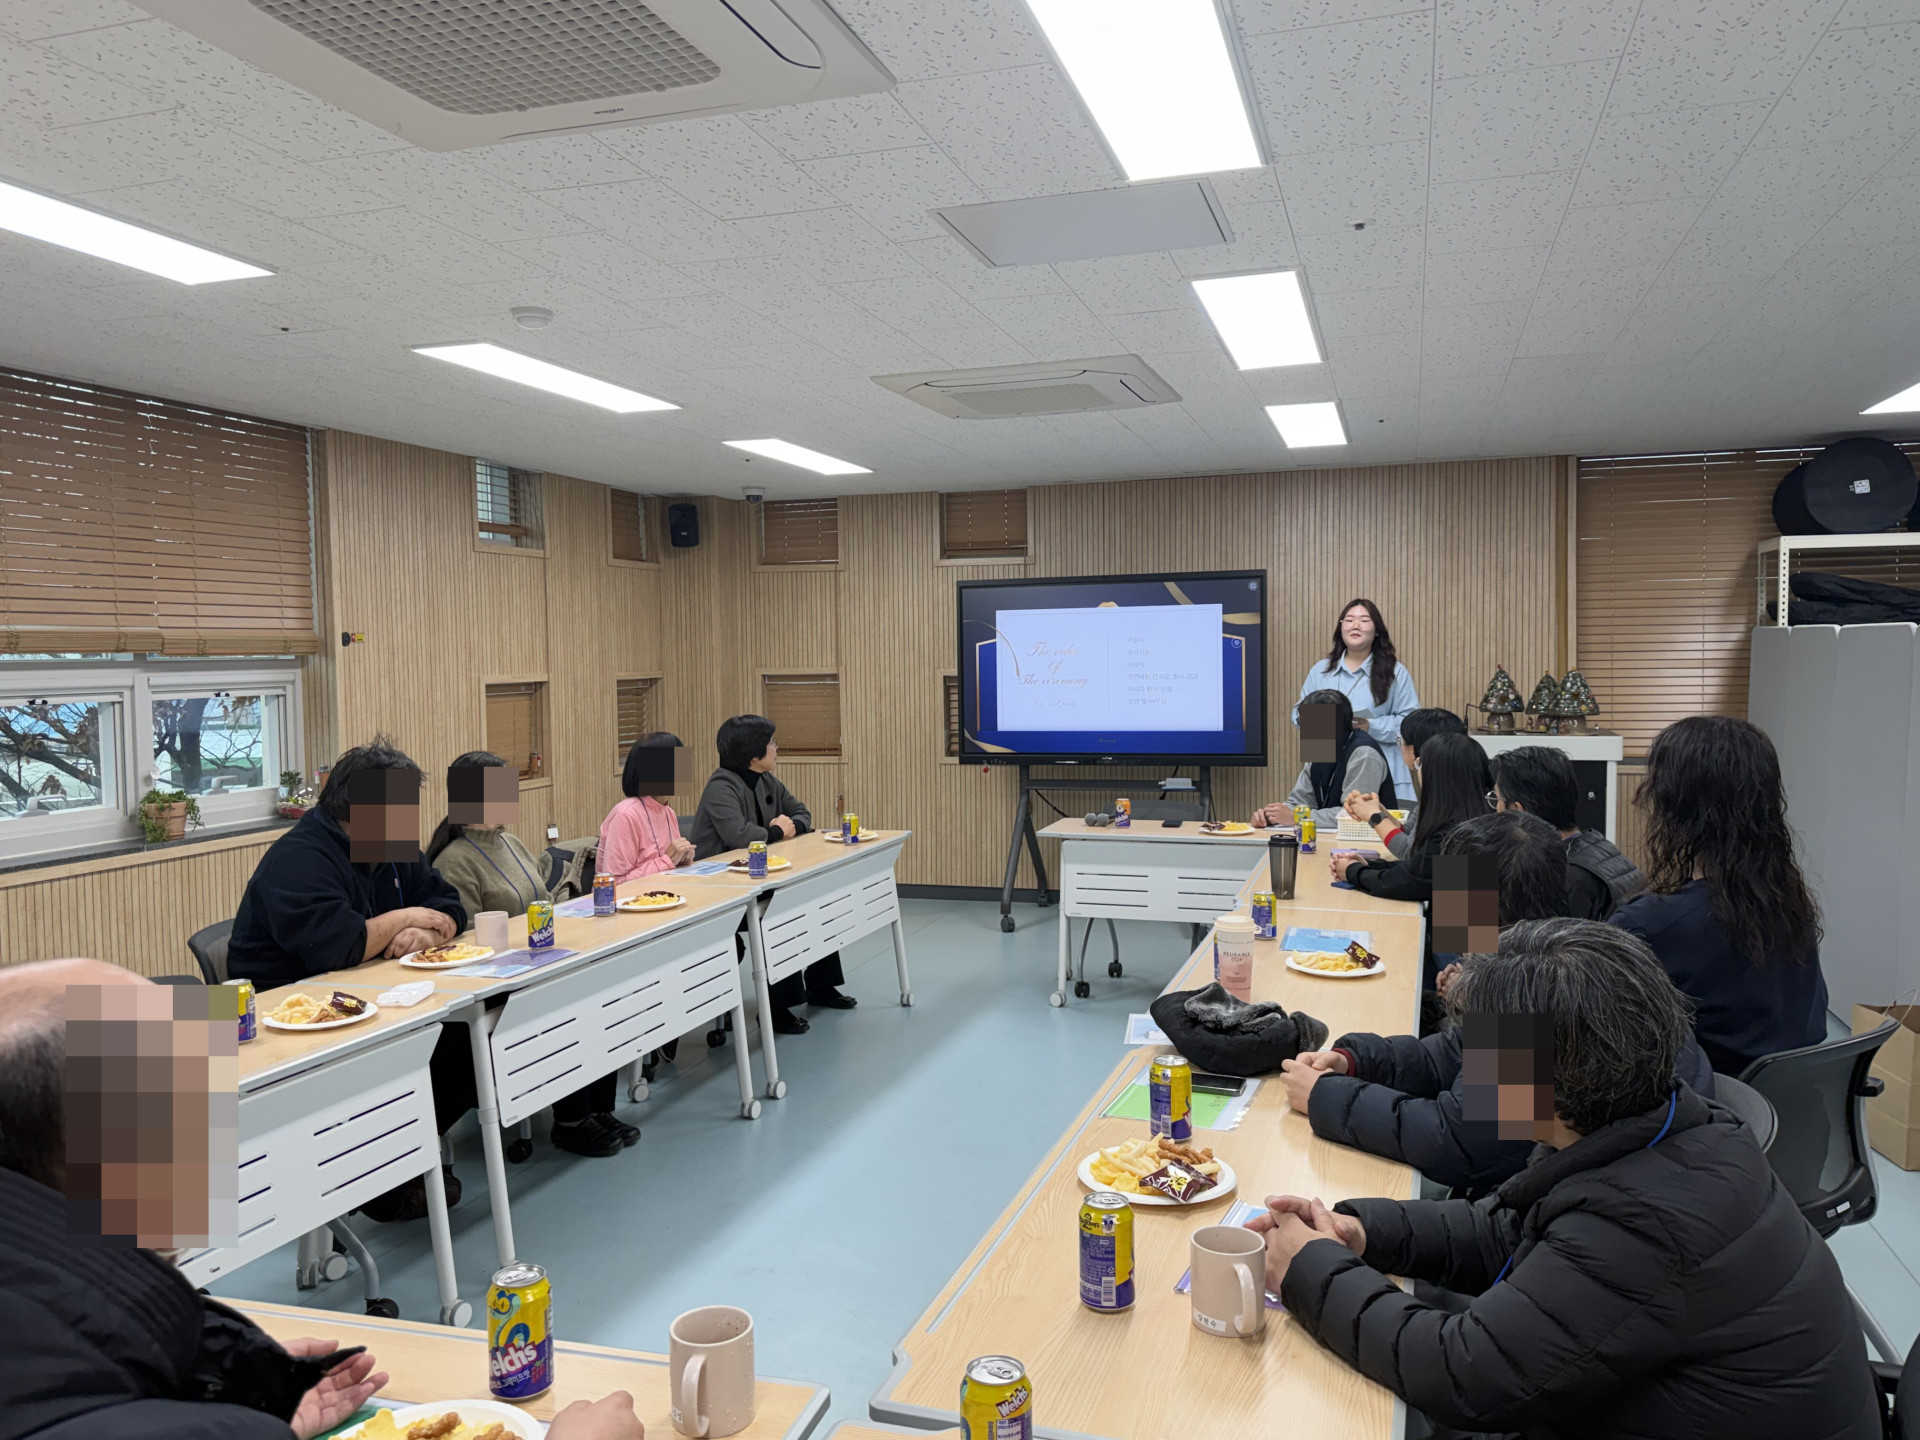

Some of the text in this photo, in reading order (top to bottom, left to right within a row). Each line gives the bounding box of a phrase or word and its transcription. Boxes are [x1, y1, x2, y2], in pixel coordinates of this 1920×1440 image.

[1026, 641, 1051, 657] The
[1047, 658, 1064, 676] Of
[1020, 673, 1089, 690] The ceremony
[490, 1340, 538, 1378] elch's
